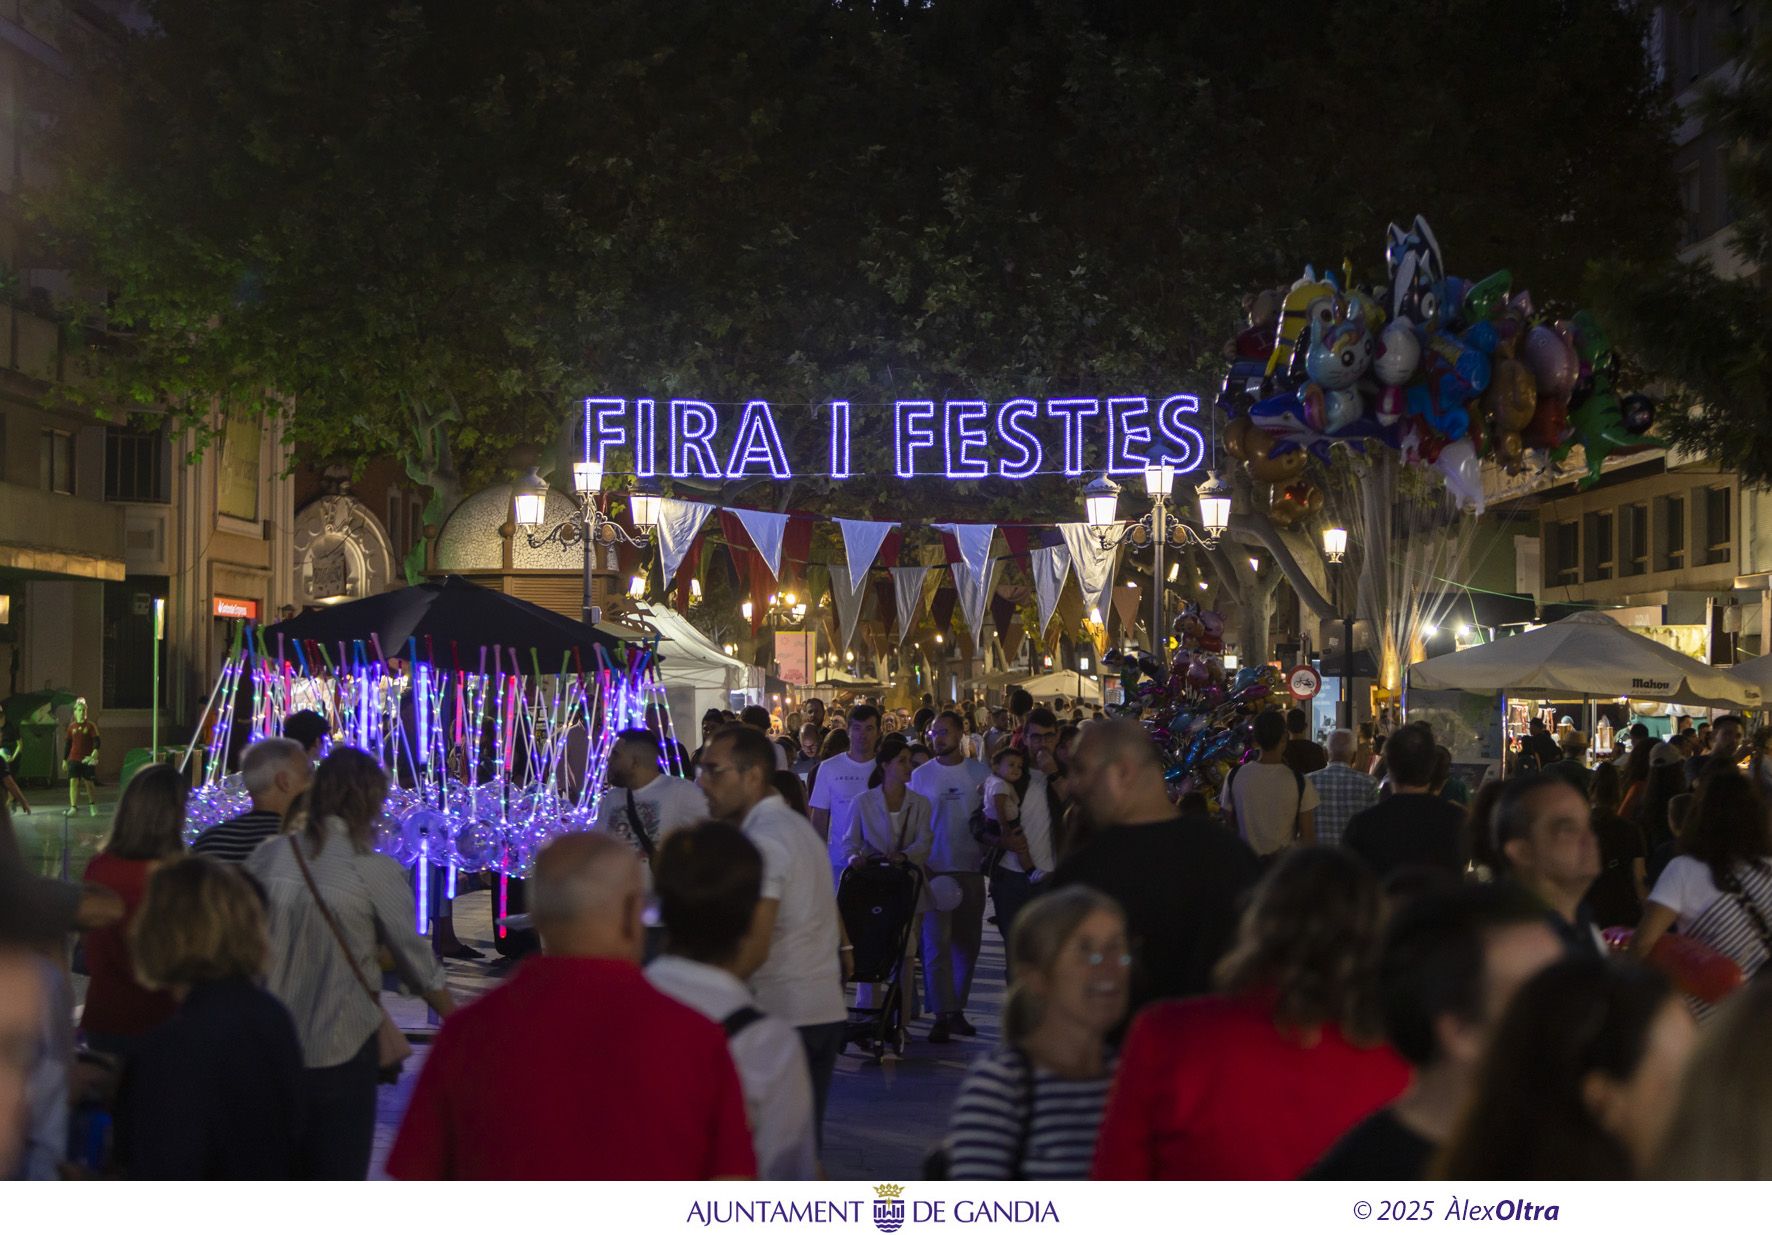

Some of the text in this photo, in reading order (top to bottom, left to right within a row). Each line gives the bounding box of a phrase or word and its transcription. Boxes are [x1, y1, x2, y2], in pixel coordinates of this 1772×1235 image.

[585, 393, 1205, 479] FIRA I FESTES
[1632, 678, 1670, 690] Mahou
